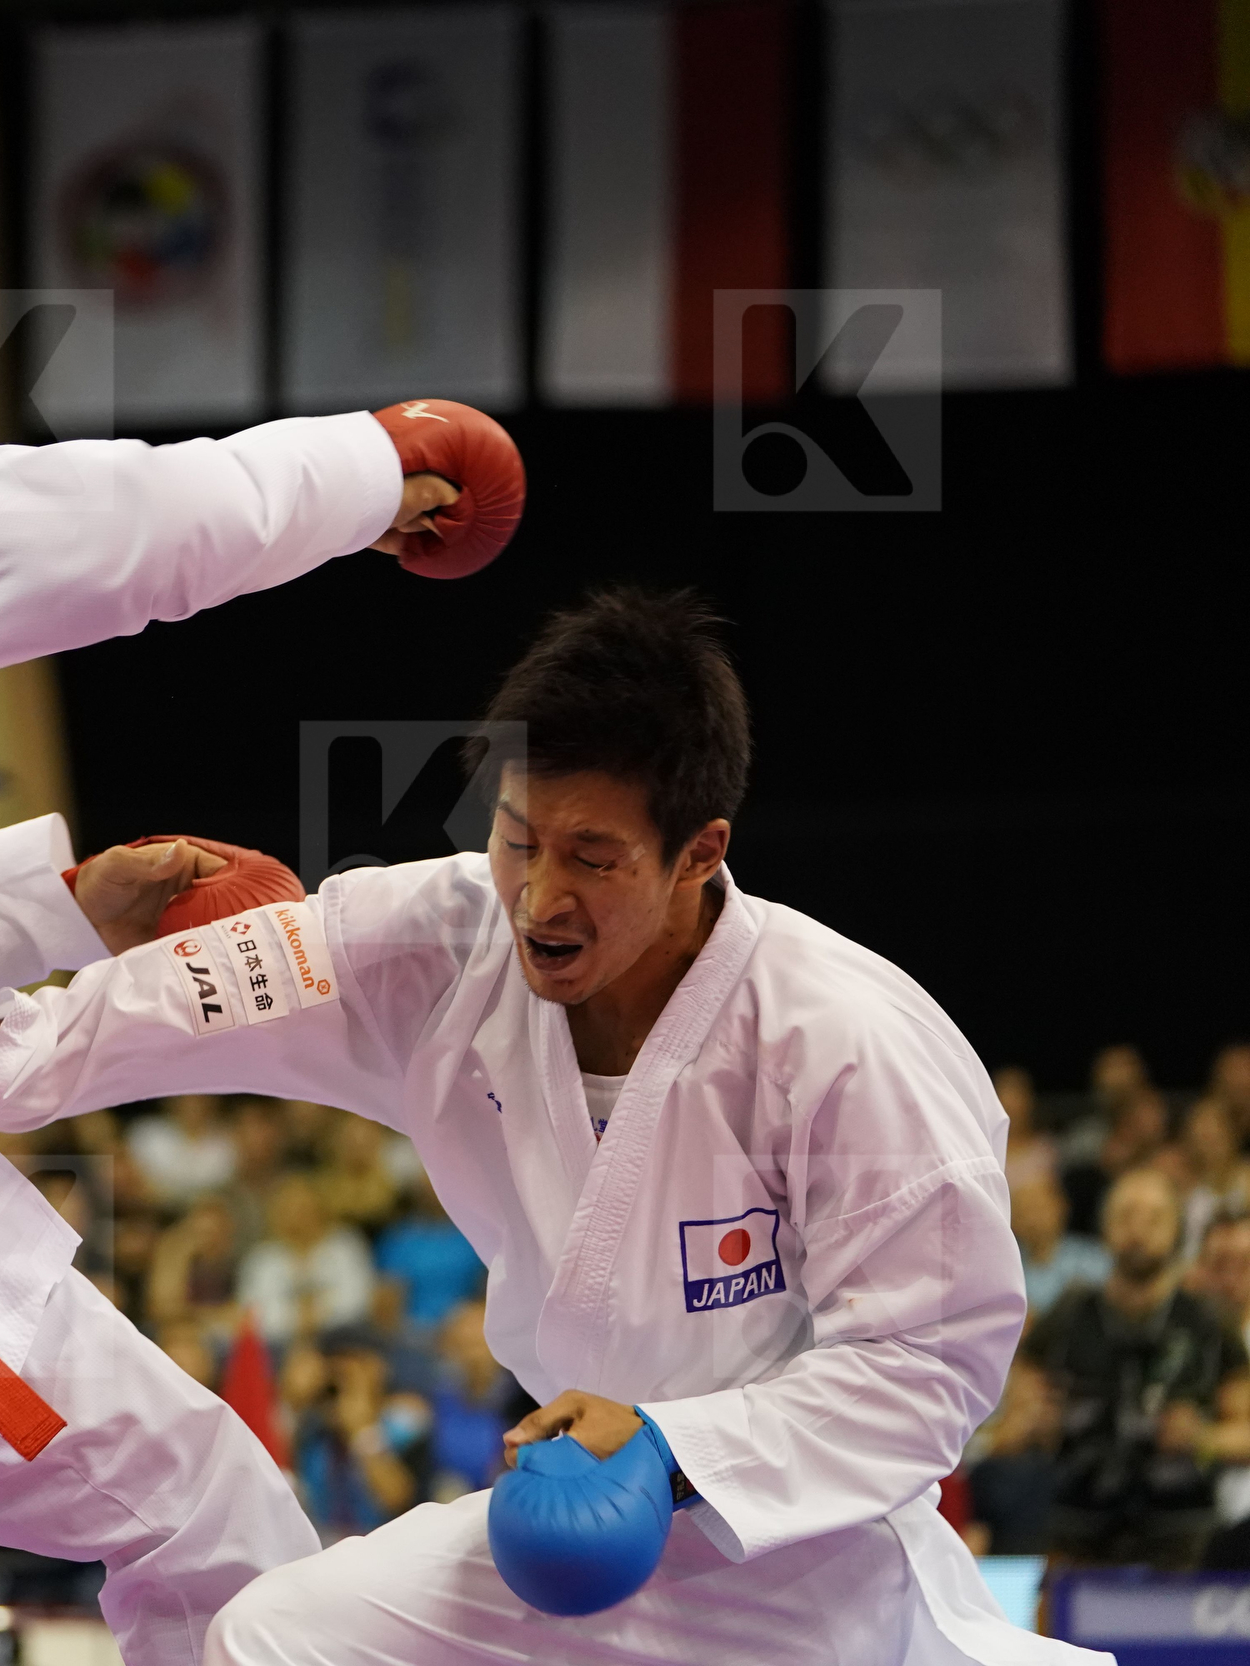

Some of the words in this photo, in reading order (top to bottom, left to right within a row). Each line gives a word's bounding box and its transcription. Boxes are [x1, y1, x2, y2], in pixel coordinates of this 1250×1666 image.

[236, 939, 274, 1011] 日本生命
[275, 908, 315, 990] kikkoman
[185, 961, 224, 1024] JAL
[692, 1264, 777, 1308] JAPAN
